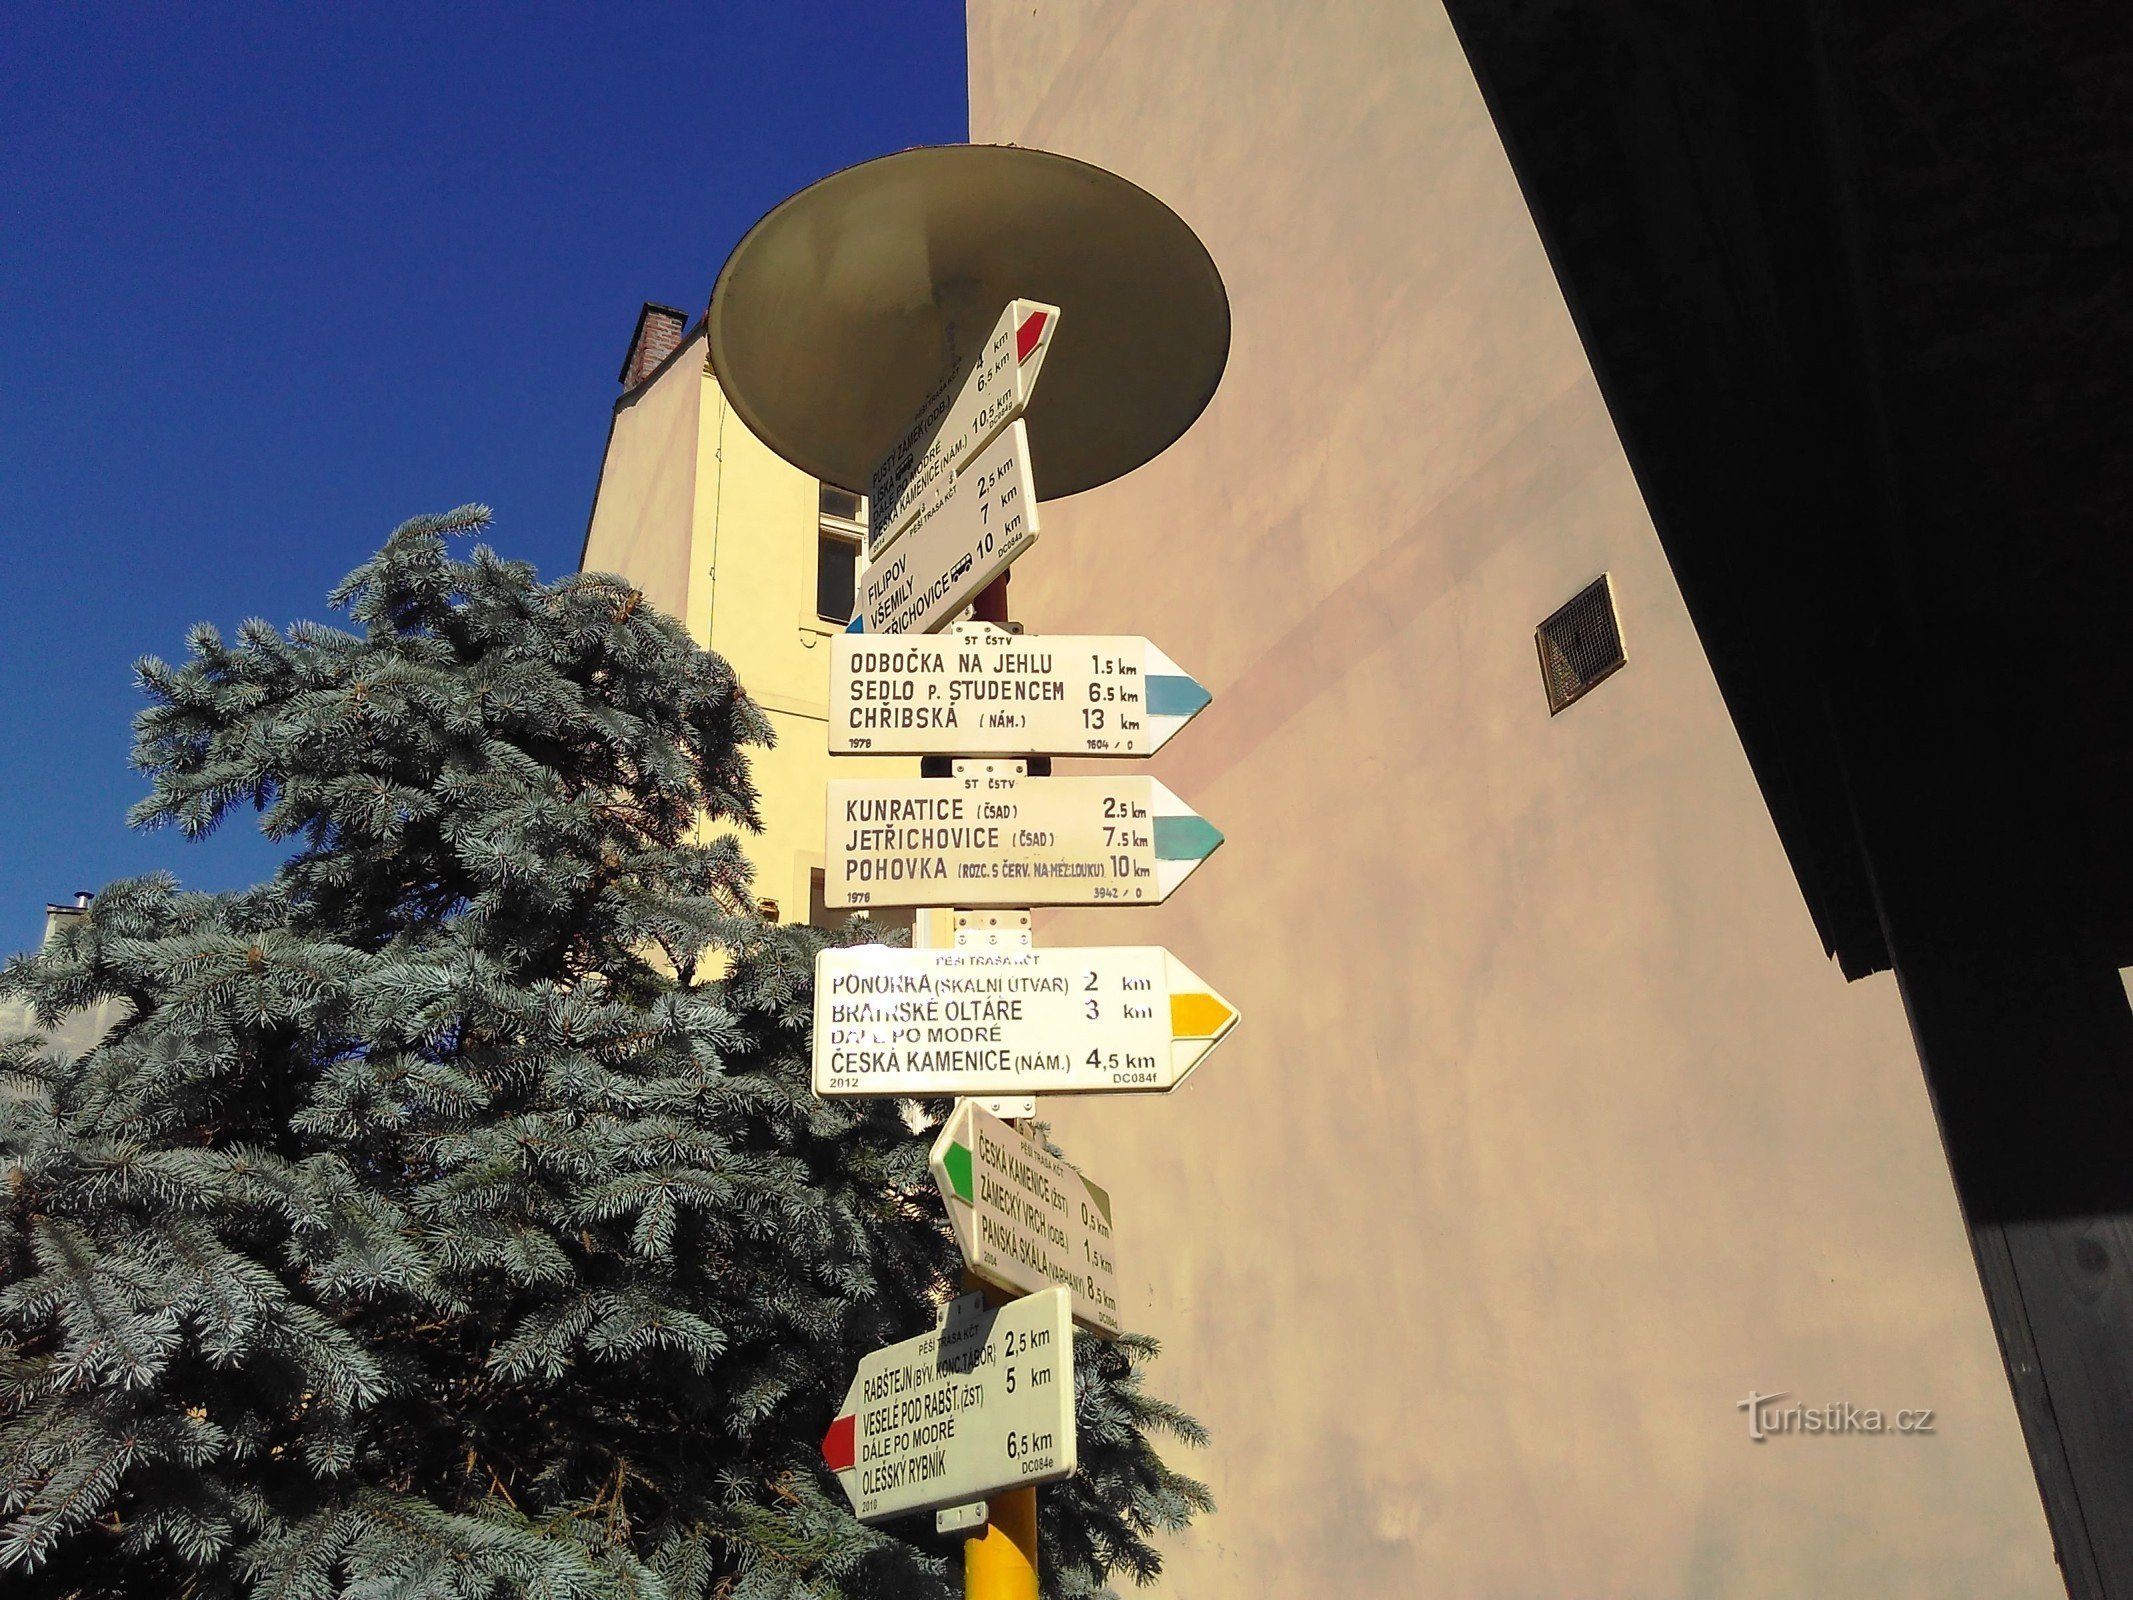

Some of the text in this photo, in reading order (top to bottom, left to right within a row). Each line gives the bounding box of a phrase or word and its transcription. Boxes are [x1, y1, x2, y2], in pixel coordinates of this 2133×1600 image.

[976, 331, 1009, 370] 4 km
[977, 352, 1010, 393] 6,5 km
[972, 388, 1011, 434] 10,5 km
[896, 478, 908, 498] PO
[900, 459, 941, 515] KAMENICE
[976, 457, 1014, 499] 2,5 km
[923, 499, 945, 523] TRASA
[944, 484, 957, 503] KČT
[980, 486, 1018, 526] 7 km
[976, 514, 1022, 560] 10 km
[868, 553, 907, 606] FILIPOV
[870, 574, 915, 630] VŠEMILY
[964, 635, 1013, 646] ST ČSTV
[850, 648, 1052, 674] ODBOČKA NA JEHLU
[1091, 655, 1137, 676] 1.5 km
[850, 680, 914, 701] SEDLO
[949, 680, 1064, 701] STUDENCEM
[1088, 683, 1139, 703] 6.5 km
[850, 702, 959, 729] CHŘIBSKÁ
[1082, 708, 1140, 730] 13 km
[849, 738, 872, 749] 1978
[964, 778, 1015, 789] ST ČSTV
[846, 798, 964, 821] KUNRATICE
[1102, 797, 1147, 819] 2.5 km
[845, 823, 999, 851] JETŘICHOVICE
[1102, 826, 1148, 847] 7.5 km
[846, 857, 948, 882] POHOVKA
[958, 863, 990, 879] (ROZC.
[992, 863, 999, 878] S
[1002, 859, 1031, 878] ČERV.
[1110, 855, 1150, 878] 10 km
[1093, 887, 1118, 898] 3942
[1083, 971, 1151, 991] 2 km
[1086, 999, 1153, 1020] 3 km
[892, 1028, 921, 1044] PO
[928, 1023, 1002, 1042] MODRÉ
[831, 1047, 901, 1073] ČESKÁ
[907, 1049, 1011, 1073] KAMENICE
[1085, 1048, 1156, 1072] 4,5 km
[830, 1078, 859, 1088] 2012
[1113, 1073, 1157, 1084] DC084f
[979, 1129, 1008, 1176] ČESKÁ
[1008, 1153, 1050, 1203] KAMENICE
[981, 1172, 1021, 1223] ZÁMECKÝ
[1023, 1200, 1047, 1238] VRCH
[1081, 1202, 1110, 1239] 0,5 km
[982, 1215, 1019, 1260] PANSKÁ
[1020, 1237, 1049, 1277] SKÁLA
[1083, 1238, 1113, 1275] 1,5 km
[1087, 1275, 1117, 1312] 8,5 km
[918, 1324, 979, 1356] PĚŠÍ TRASA KČT
[1004, 1328, 1051, 1358] 2,5 km
[864, 1364, 913, 1405] RABŠTEJN
[1006, 1367, 1052, 1394] 5 km
[863, 1398, 899, 1437] VESELÉ
[901, 1397, 922, 1427] POD
[862, 1414, 955, 1463] DÁLE PO MODRÉ
[1007, 1431, 1053, 1460] 6,5 km
[862, 1444, 947, 1496] OLEŠSKÝ RYBNÍK
[1022, 1456, 1054, 1475] DC084e
[862, 1499, 878, 1513] 2010
